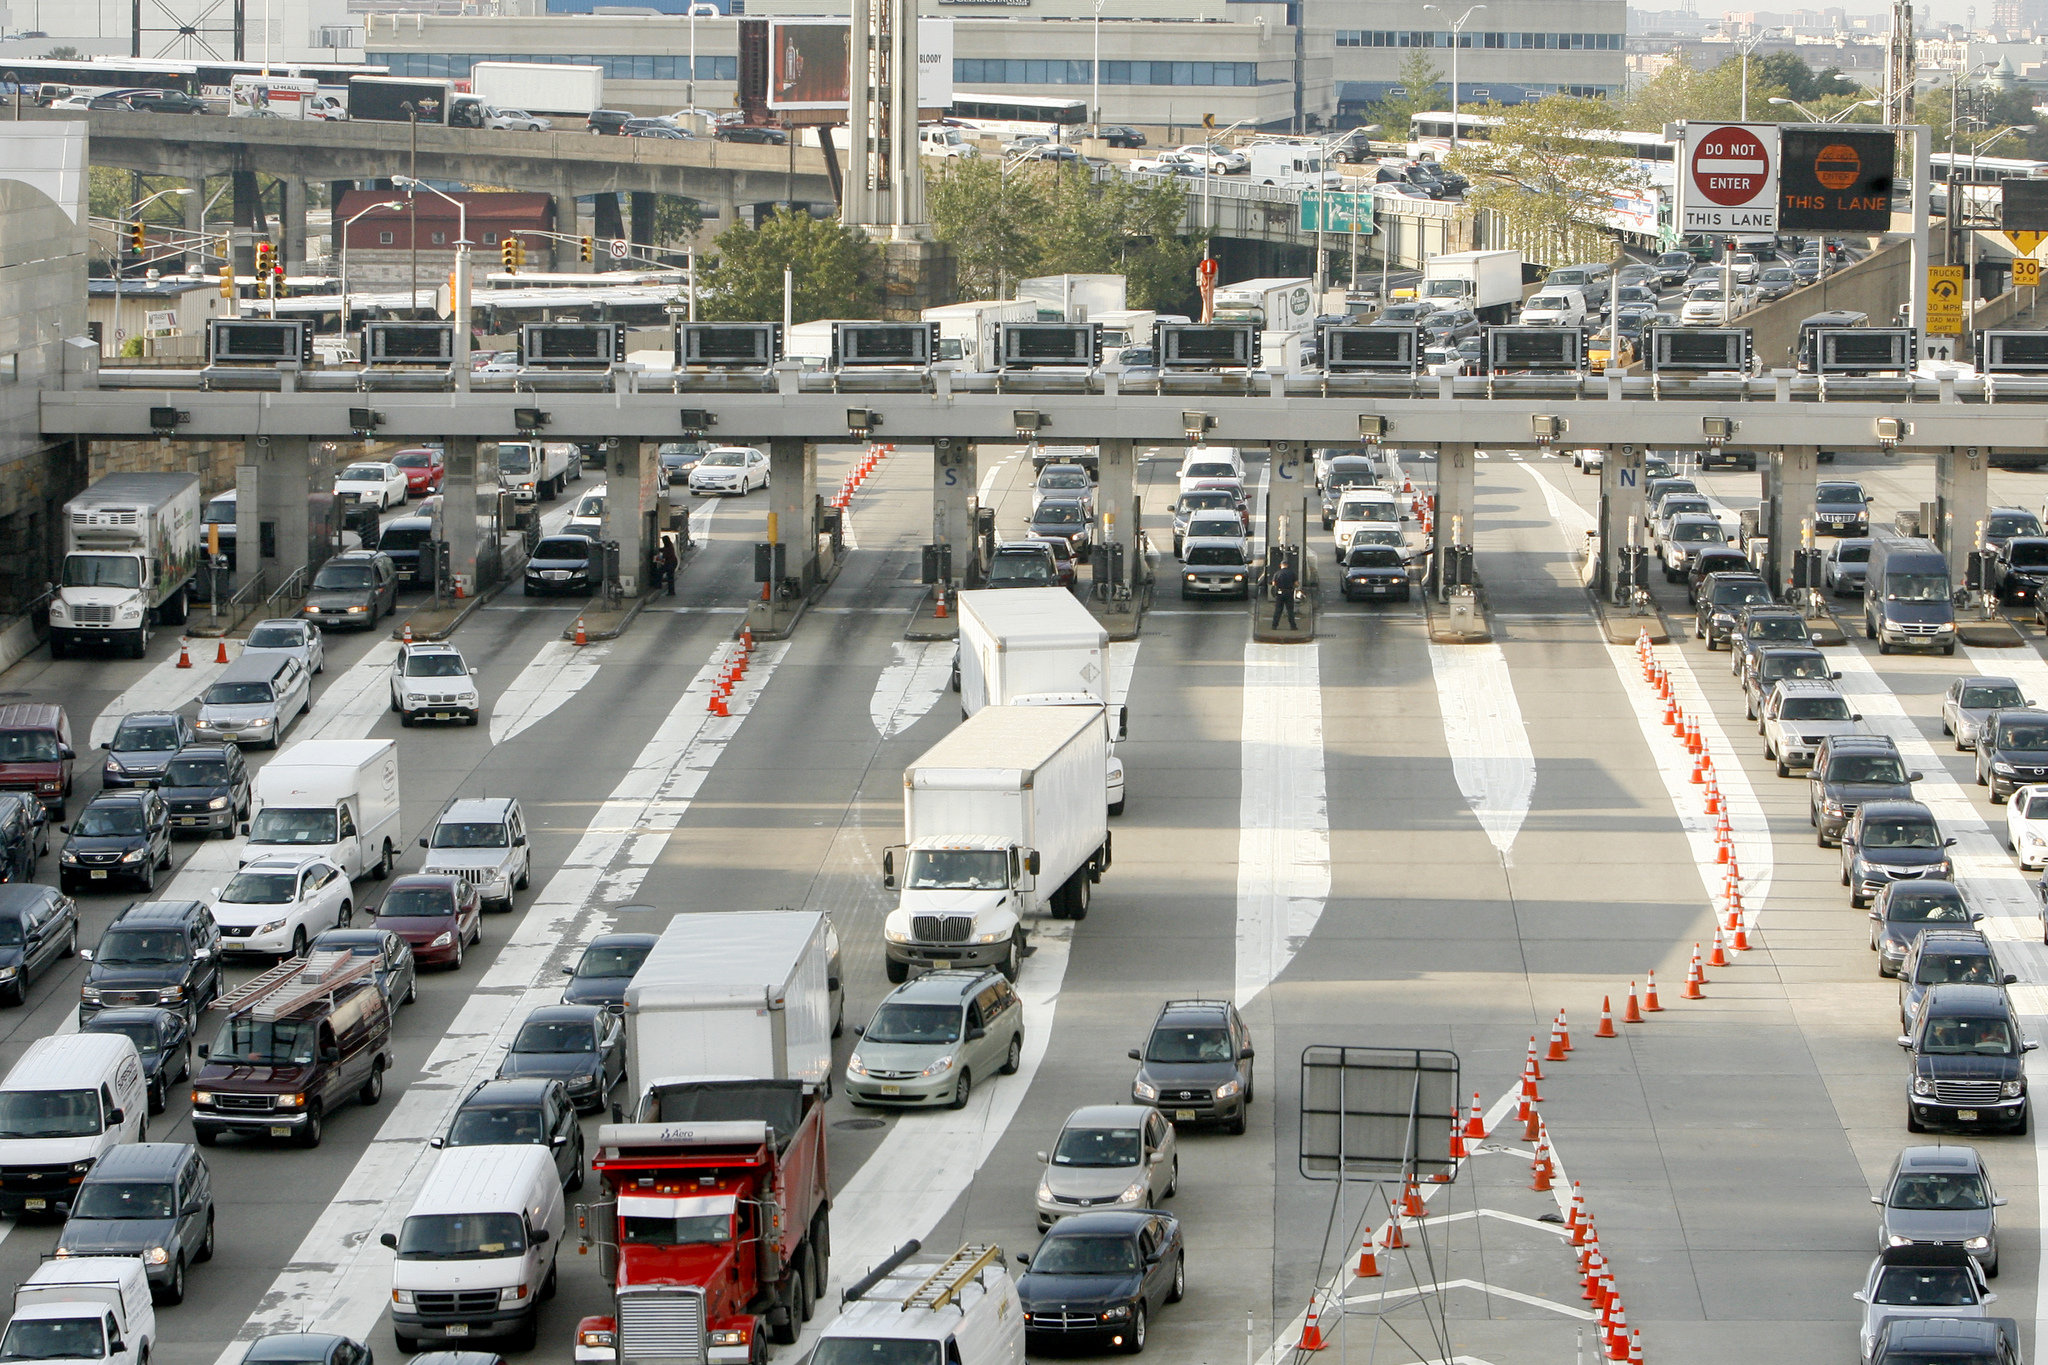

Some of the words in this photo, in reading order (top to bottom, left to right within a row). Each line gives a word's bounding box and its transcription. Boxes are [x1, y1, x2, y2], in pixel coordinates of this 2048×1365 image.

[919, 54, 941, 63] BLOODY
[1705, 143, 1723, 156] DO
[1731, 144, 1756, 156] NOT
[1710, 177, 1750, 190] ENTER
[1786, 196, 1825, 209] THIS
[1838, 196, 1886, 211] LANE
[1687, 212, 1721, 225] THIS
[1732, 214, 1773, 226] LANE
[1928, 268, 1961, 278] TRUCKS
[2015, 262, 2036, 275] 30
[1928, 303, 1938, 311] 30
[1943, 304, 1960, 312] MPH
[945, 468, 957, 486] S
[1620, 469, 1636, 487] N
